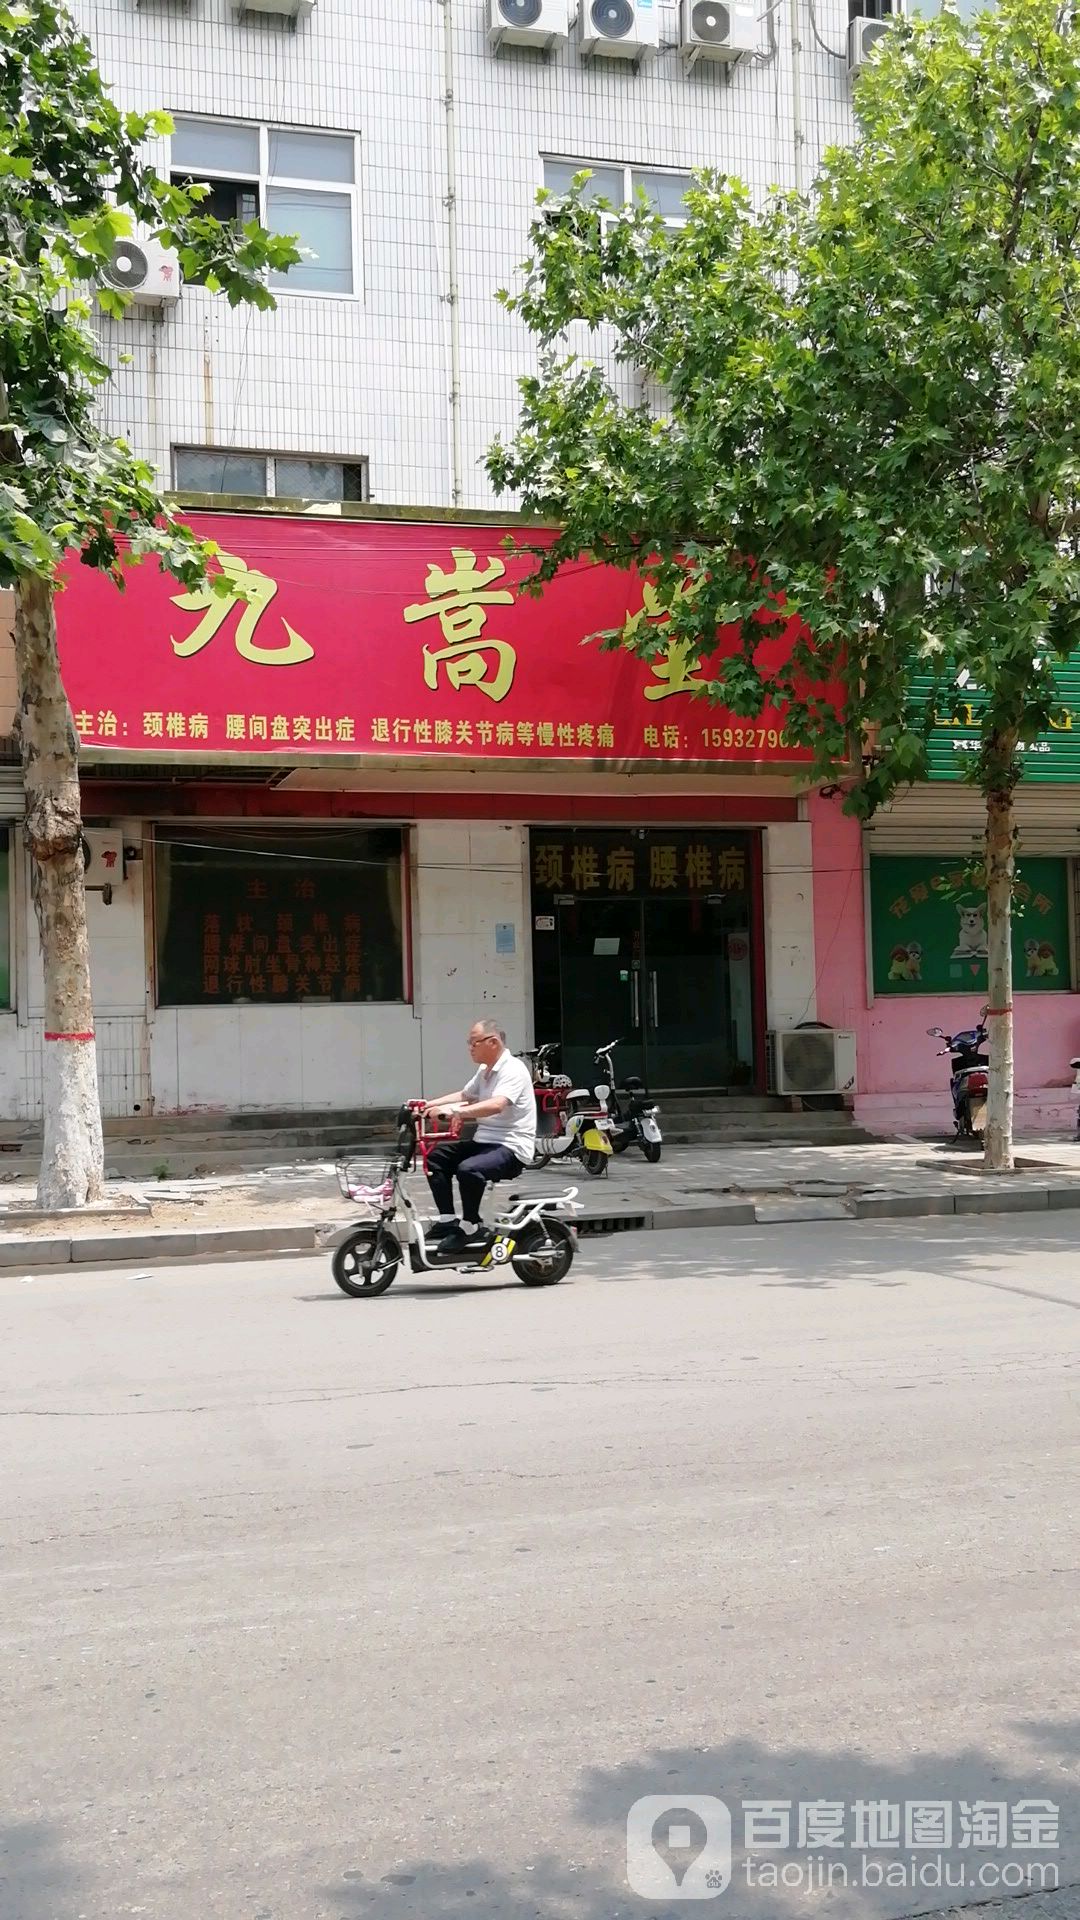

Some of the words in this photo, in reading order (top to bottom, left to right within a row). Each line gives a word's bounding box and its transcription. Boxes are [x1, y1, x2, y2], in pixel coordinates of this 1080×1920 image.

[226, 713, 355, 742] 腰间盘突出症
[371, 717, 615, 748] 退行性膝关节病等慢性疼痛
[534, 845, 635, 891] 颈椎病
[649, 844, 745, 890] 腰椎病
[495, 1245, 504, 1258] 8
